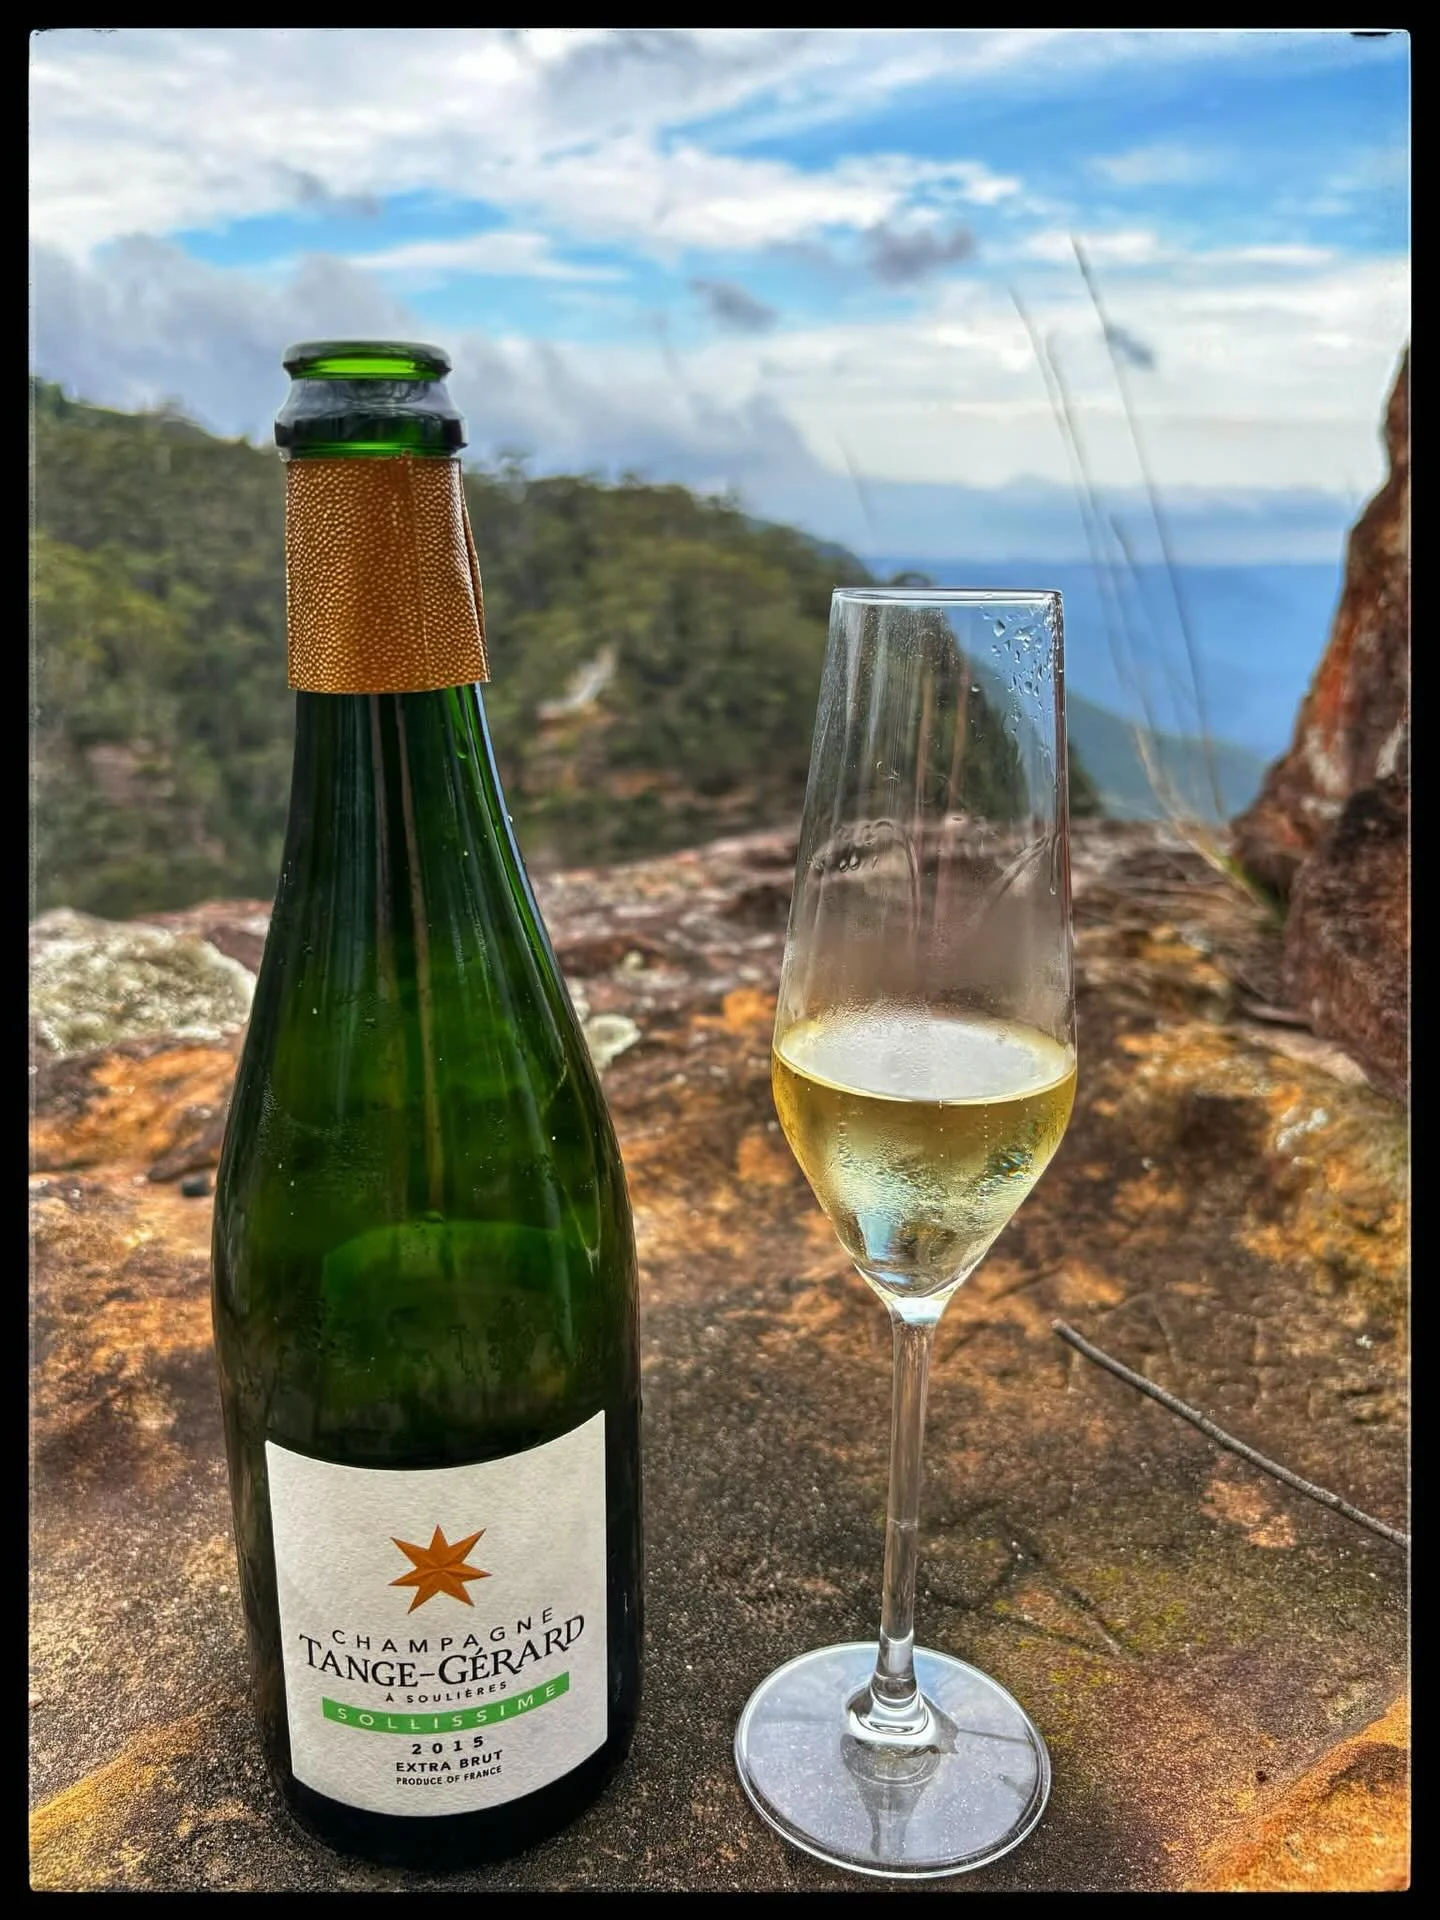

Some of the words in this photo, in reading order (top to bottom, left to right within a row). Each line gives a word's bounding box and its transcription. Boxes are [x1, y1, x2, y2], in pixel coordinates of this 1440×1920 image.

[332, 1607, 553, 1653] CHAMPAGNE
[299, 1614, 585, 1688] TANGE-GÉRARD
[337, 1683, 556, 1731] SOLLISSIME
[396, 1761, 451, 1773] EXTRA
[459, 1750, 503, 1769] BRUT
[411, 1735, 483, 1755] 2015
[396, 1776, 443, 1786] PRODUCE
[446, 1774, 461, 1784] OF
[464, 1765, 502, 1781] FRANCE
